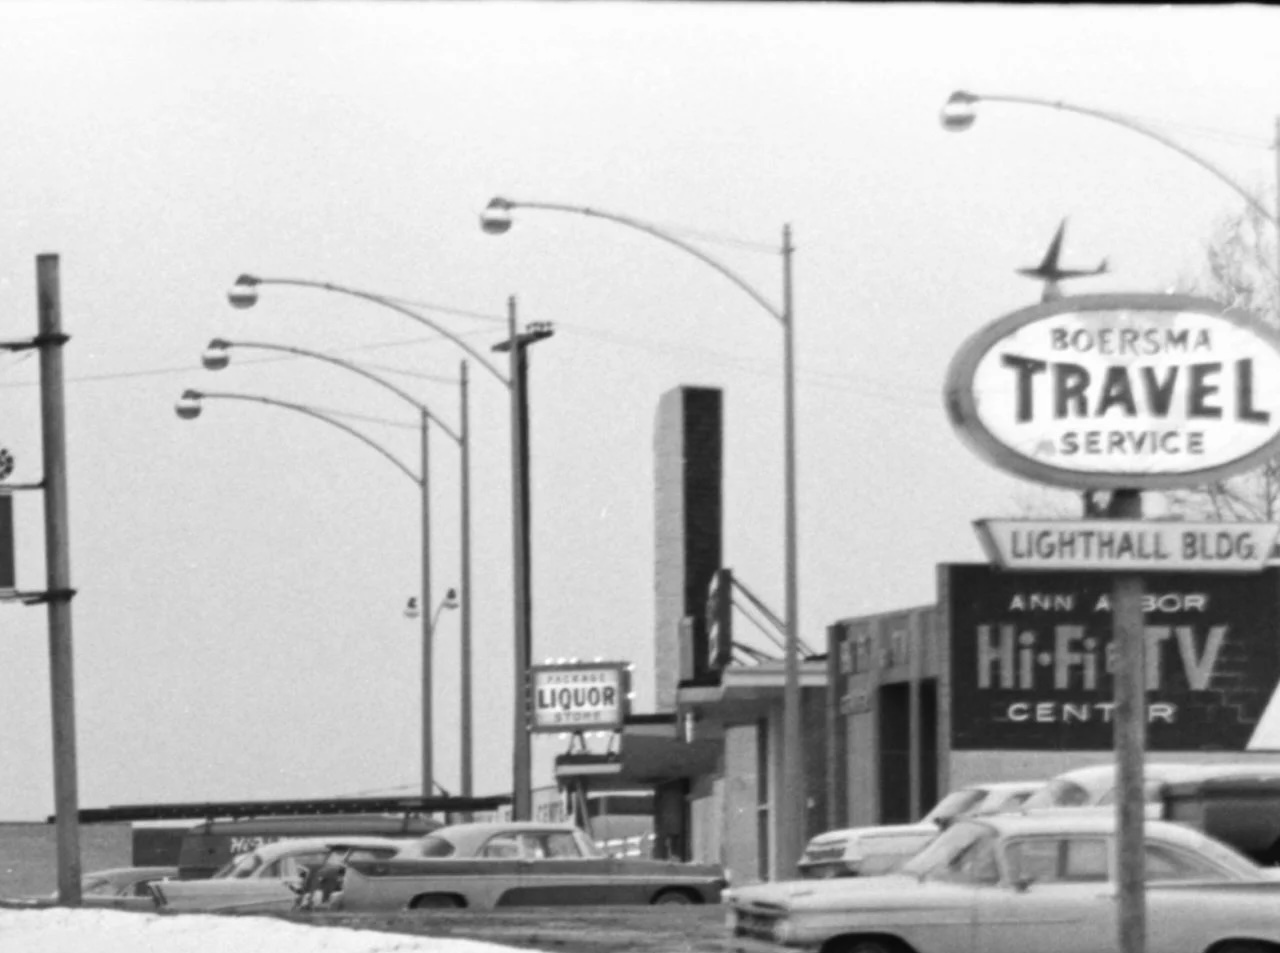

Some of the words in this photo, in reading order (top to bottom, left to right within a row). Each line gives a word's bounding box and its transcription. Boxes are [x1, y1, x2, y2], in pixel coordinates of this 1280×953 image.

[1050, 327, 1214, 357] BOERSMA
[1000, 353, 1271, 426] TRAVEL
[1059, 430, 1206, 456] SERVICE
[1010, 531, 1170, 560] LIGHTHALL
[1009, 593, 1075, 613] ANN
[1093, 592, 1210, 613] ABOR
[538, 687, 615, 709] LIQUOR
[1007, 702, 1180, 723] CENTR
